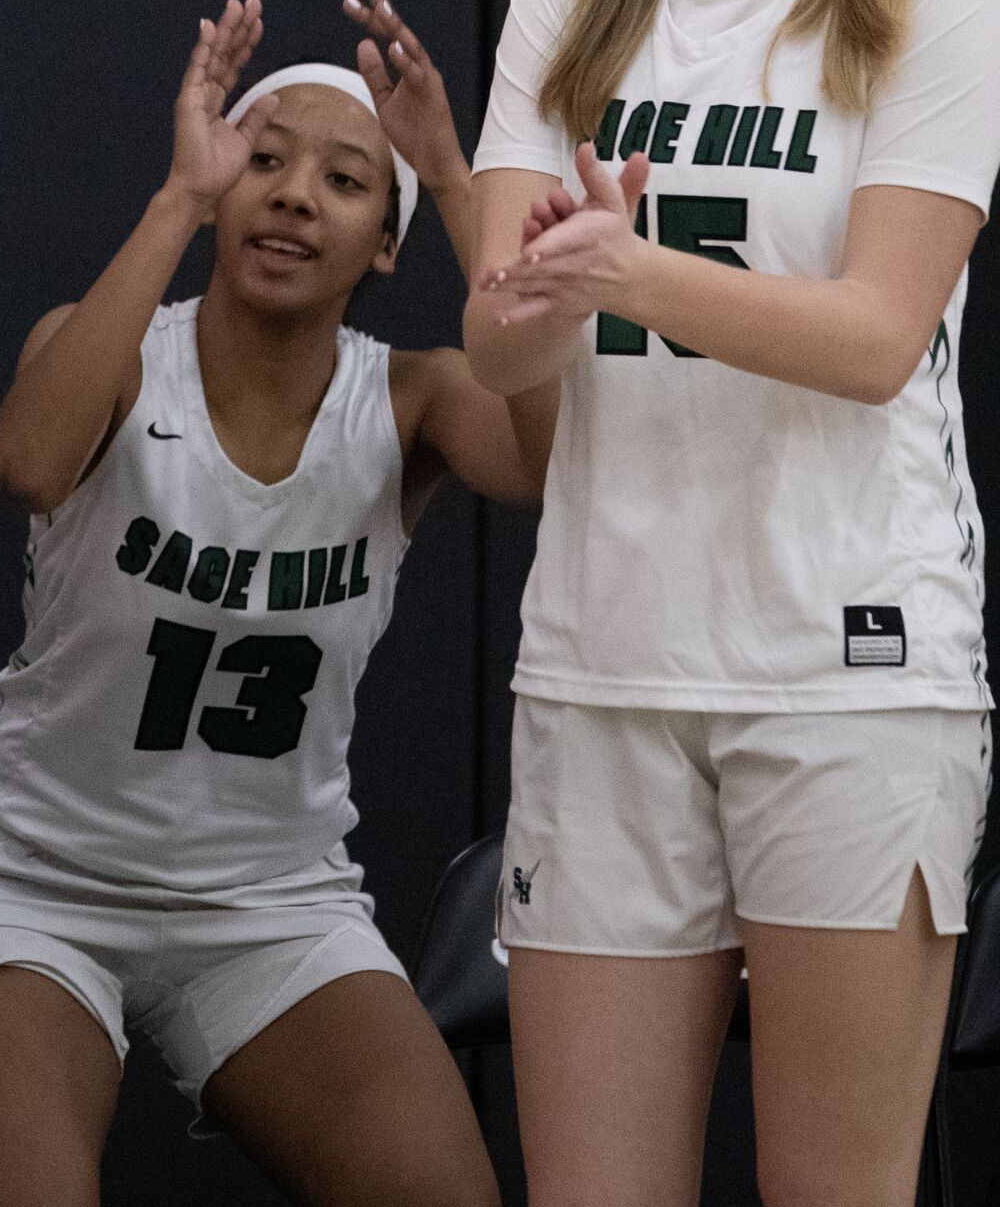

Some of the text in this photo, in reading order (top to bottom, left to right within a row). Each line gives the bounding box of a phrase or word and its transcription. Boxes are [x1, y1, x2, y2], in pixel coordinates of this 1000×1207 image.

[691, 104, 819, 174] HILL
[115, 516, 370, 611] SAGE HILL
[866, 611, 883, 630] L
[133, 617, 324, 760] 13
[513, 866, 532, 905] SH
